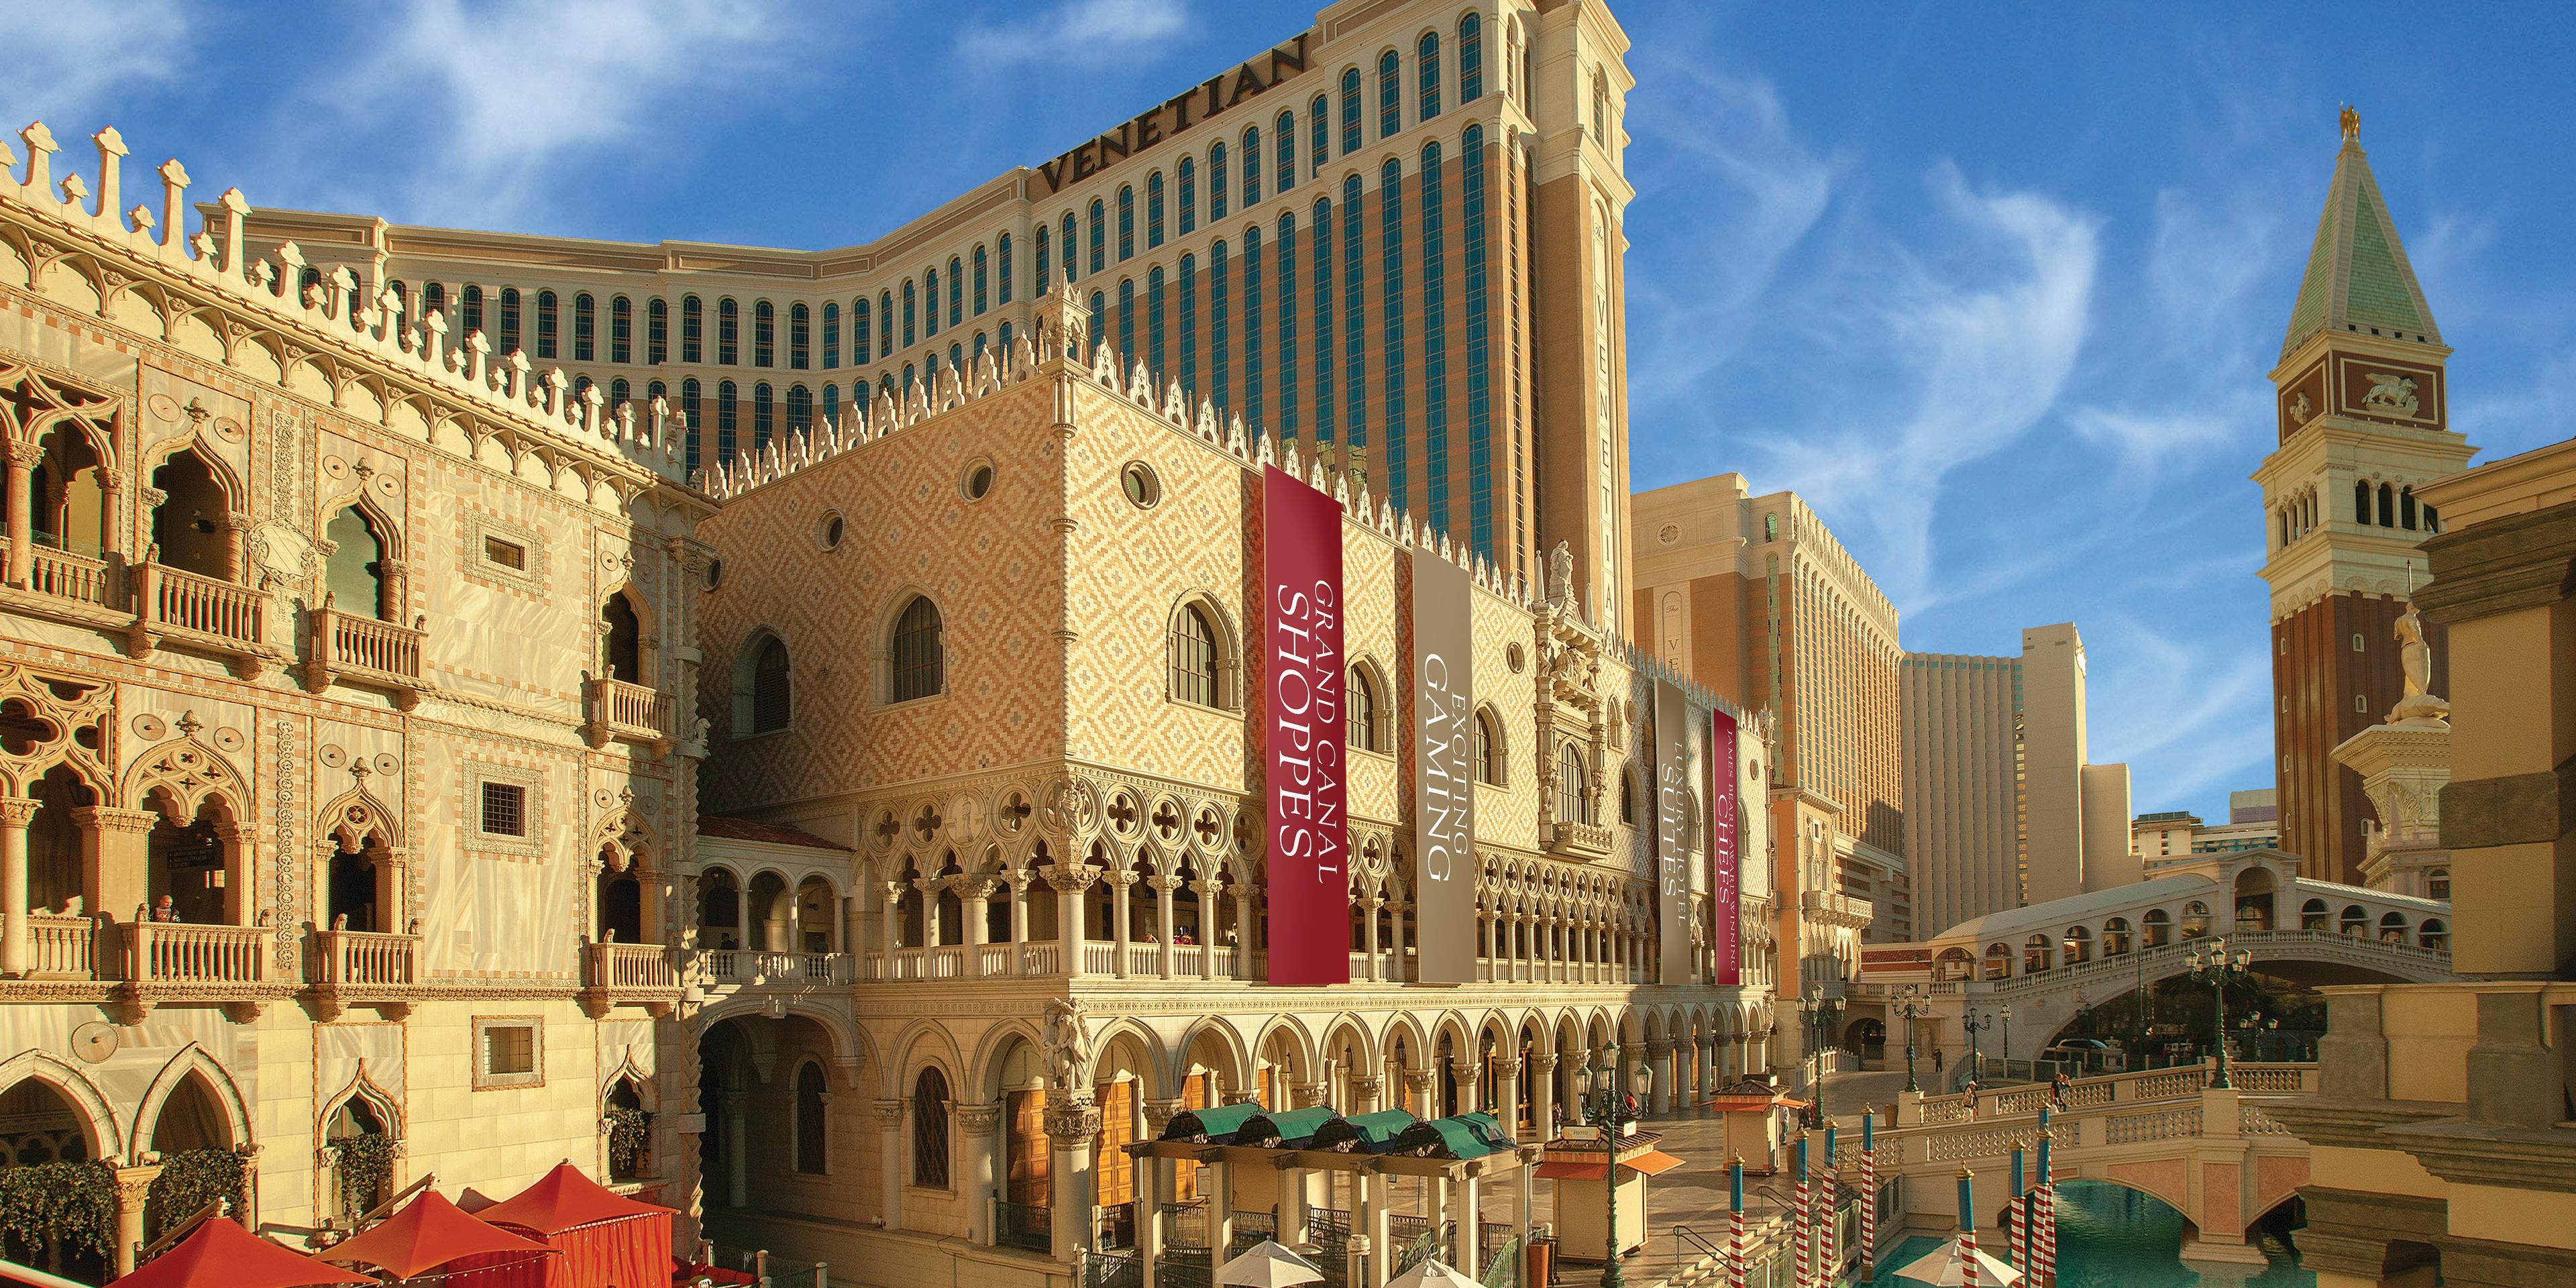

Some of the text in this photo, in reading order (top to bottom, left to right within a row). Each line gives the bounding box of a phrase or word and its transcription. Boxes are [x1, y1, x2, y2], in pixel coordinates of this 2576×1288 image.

[1037, 32, 1308, 193] VENETIAN
[1666, 605, 1679, 613] The
[1277, 584, 1311, 857] SHOPPES
[1314, 580, 1338, 884] GRAND CANAL
[1425, 653, 1450, 882] GAMING
[1451, 692, 1468, 855] EXCITING
[1662, 763, 1676, 896] SUITES
[1675, 742, 1685, 926] LUXURY HOTEL
[1718, 794, 1729, 904] CHEFS
